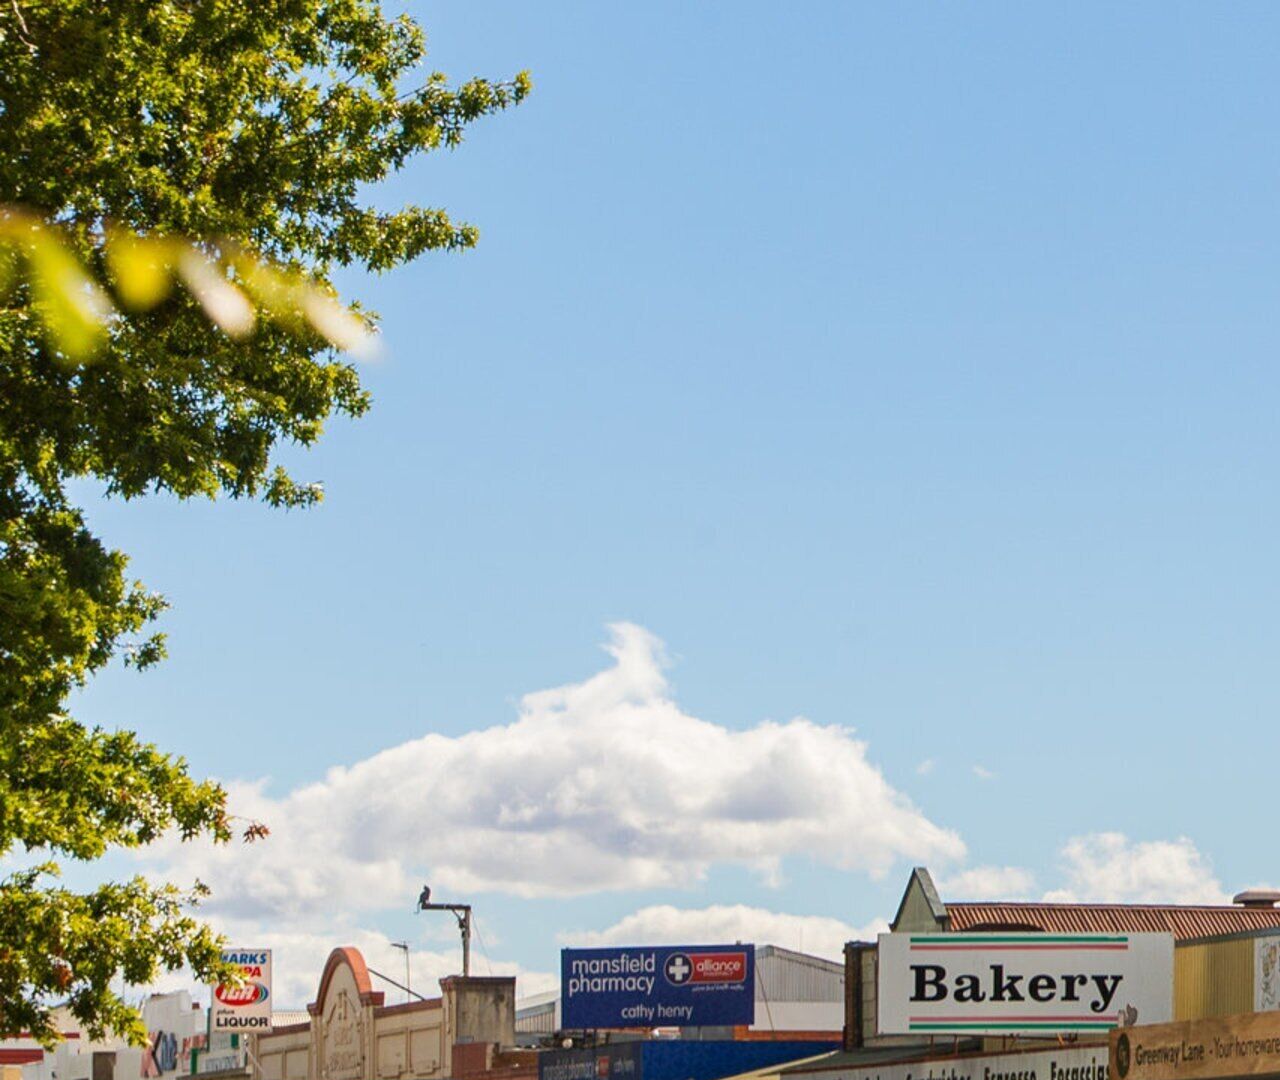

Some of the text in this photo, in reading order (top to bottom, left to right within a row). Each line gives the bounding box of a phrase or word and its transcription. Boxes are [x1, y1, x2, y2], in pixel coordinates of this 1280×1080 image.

[572, 953, 655, 975] mansfield
[696, 959, 741, 973] alliance
[569, 975, 655, 997] pharmacy
[909, 964, 1124, 1014] Bakery
[216, 1016, 268, 1027] LIQUOR
[621, 1003, 693, 1020] cathy henry
[1135, 1042, 1180, 1067] Greenway
[1181, 1039, 1205, 1062] Lane
